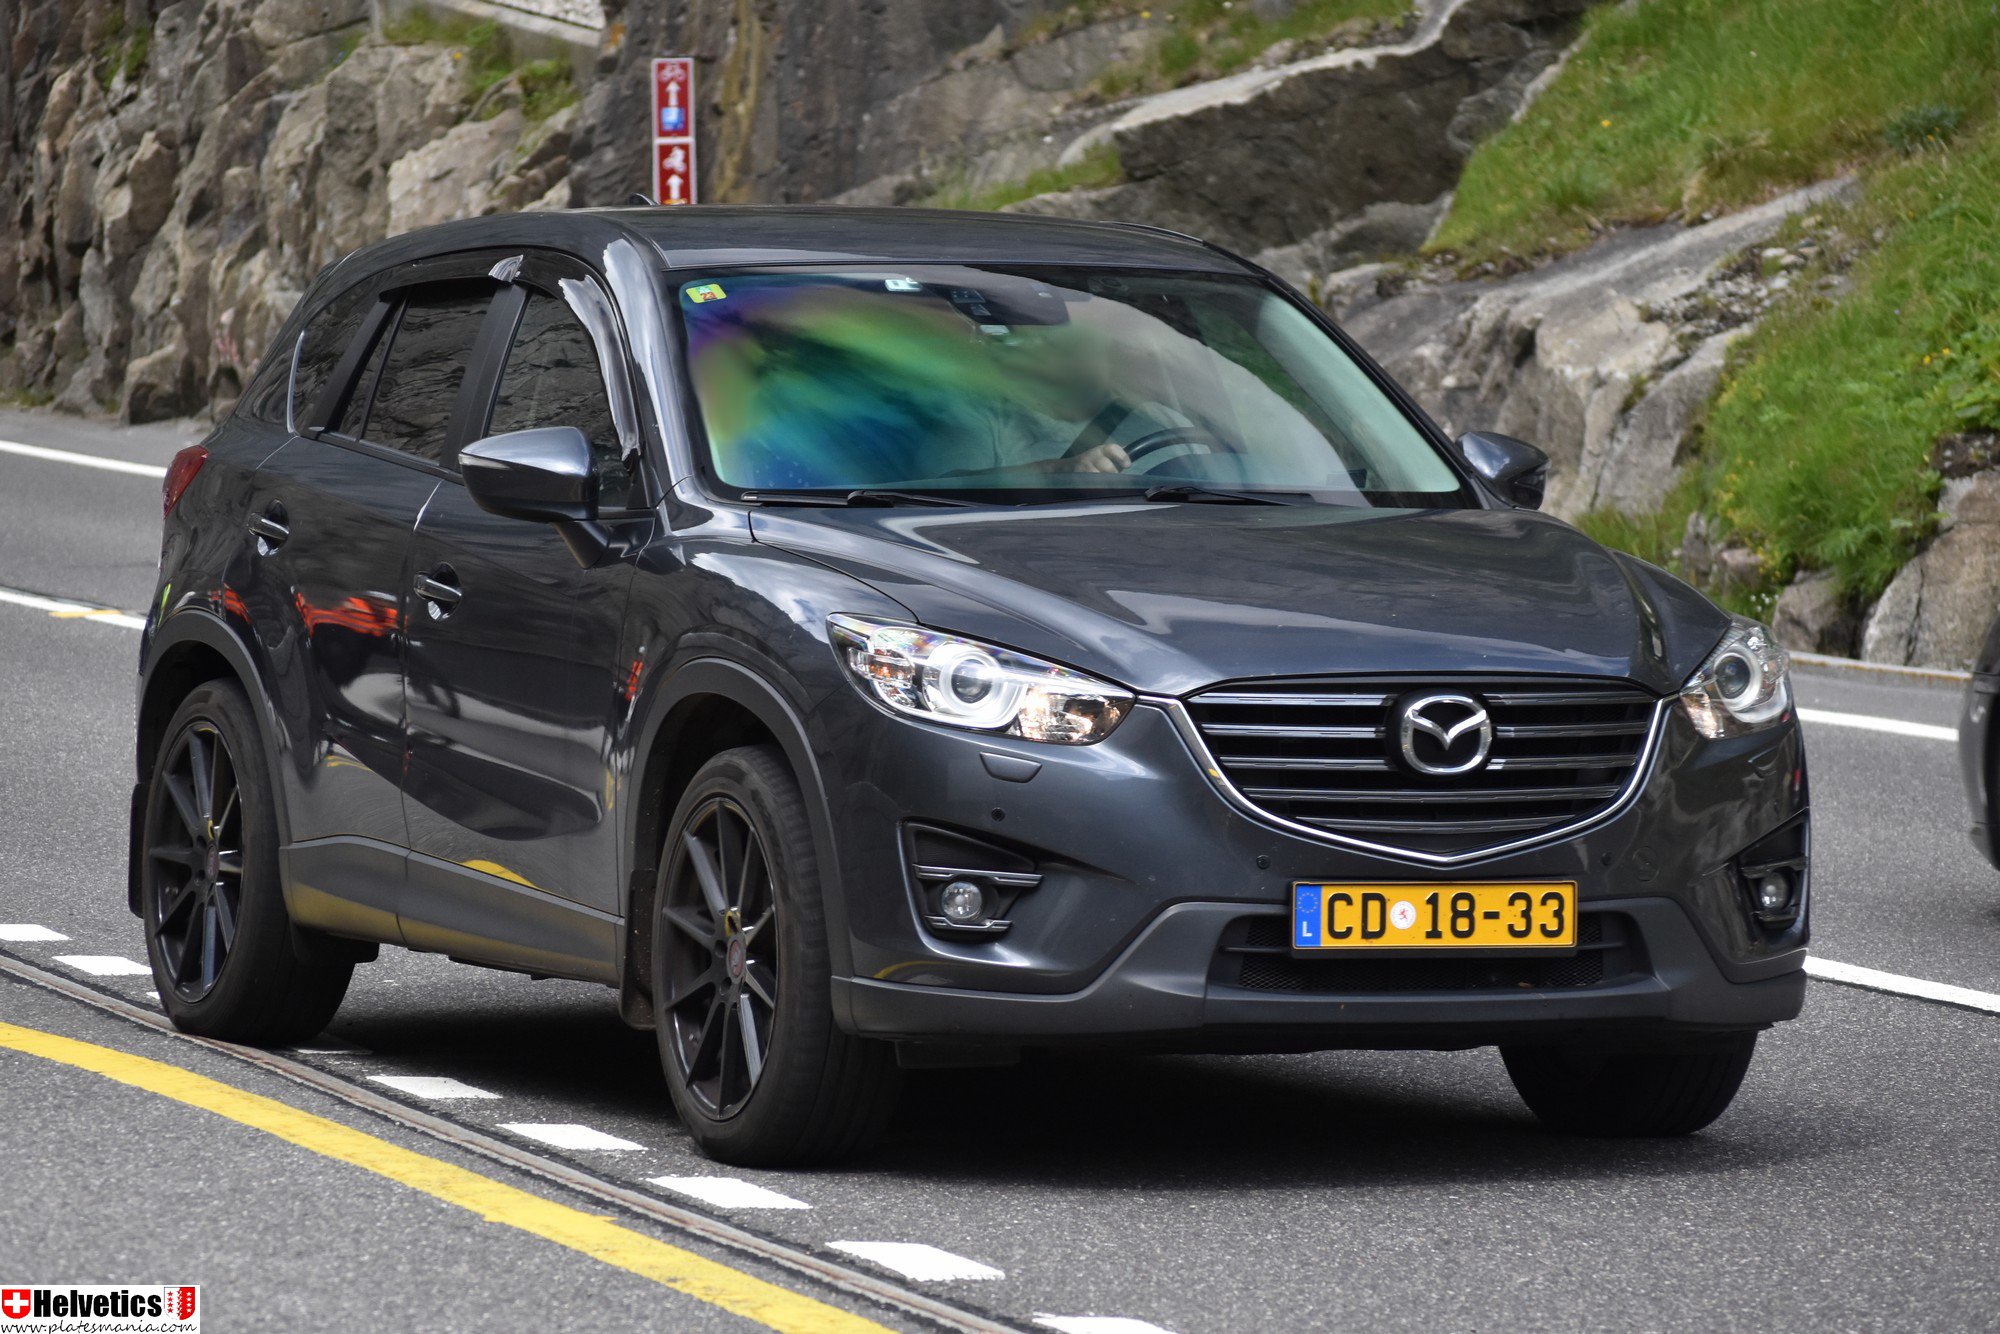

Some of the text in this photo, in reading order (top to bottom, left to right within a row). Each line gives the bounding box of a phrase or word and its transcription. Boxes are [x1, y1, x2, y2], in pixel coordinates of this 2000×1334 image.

[1302, 921, 1313, 937] L
[1327, 891, 1565, 939] CD 18-33
